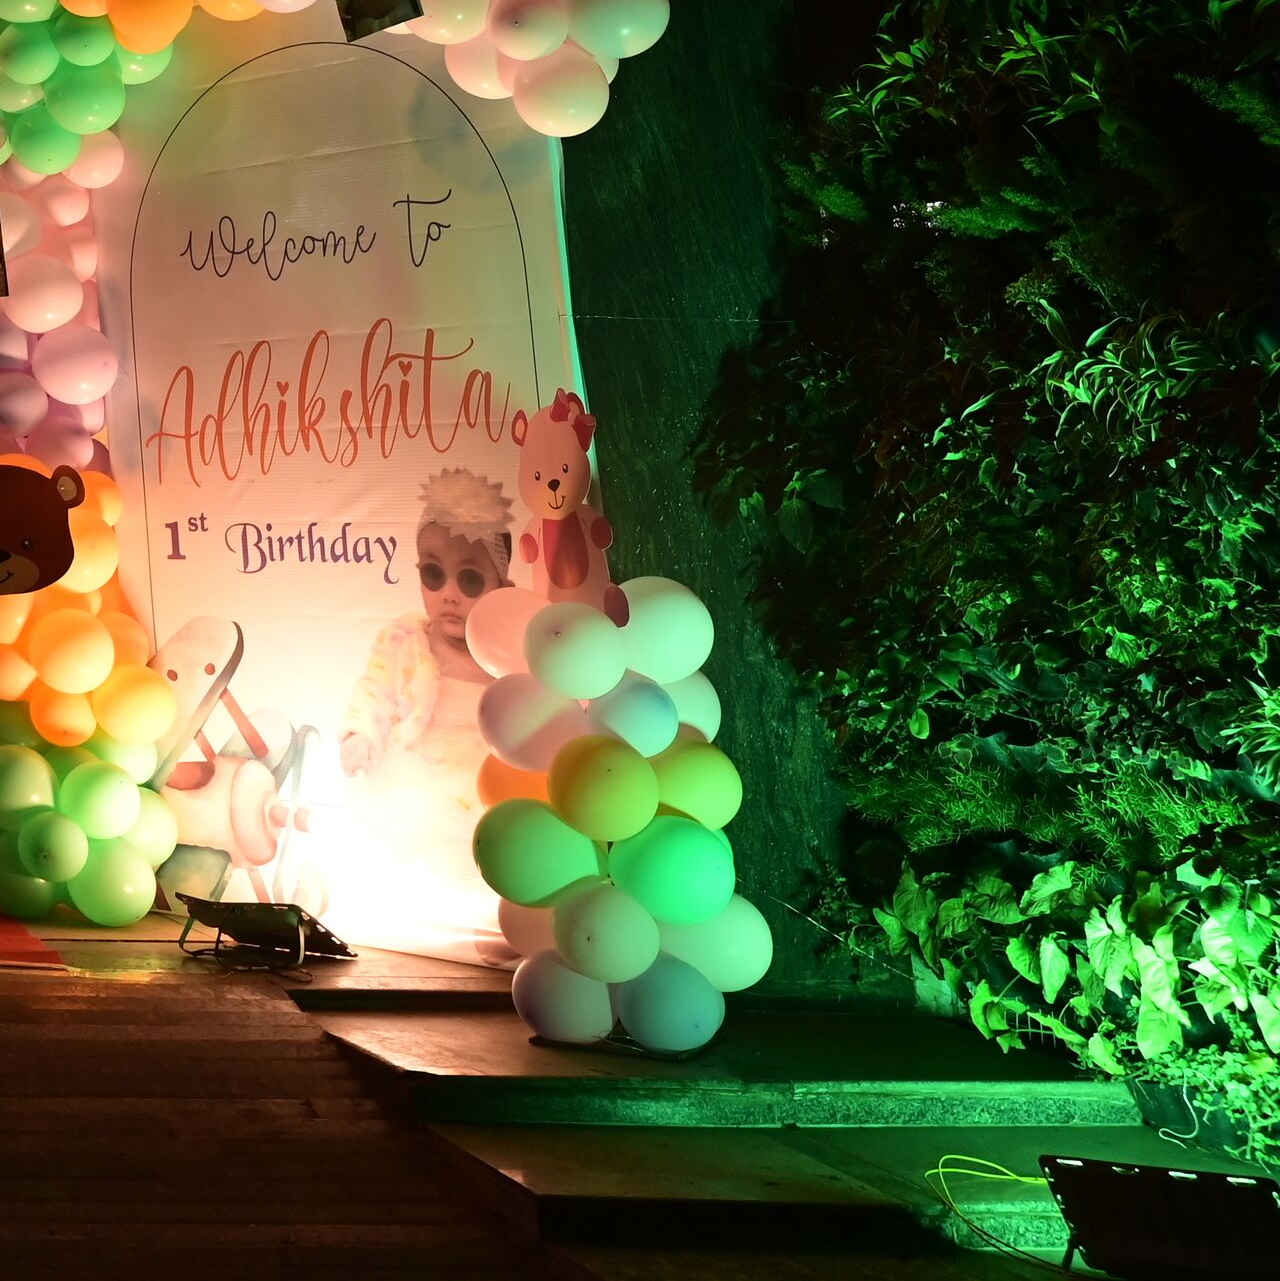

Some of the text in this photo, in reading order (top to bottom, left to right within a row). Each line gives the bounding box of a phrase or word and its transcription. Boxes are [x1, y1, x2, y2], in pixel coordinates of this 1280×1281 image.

[180, 189, 452, 281] Welcome to
[146, 318, 511, 487] Adhikshita
[164, 512, 399, 585] 1st Birthday
